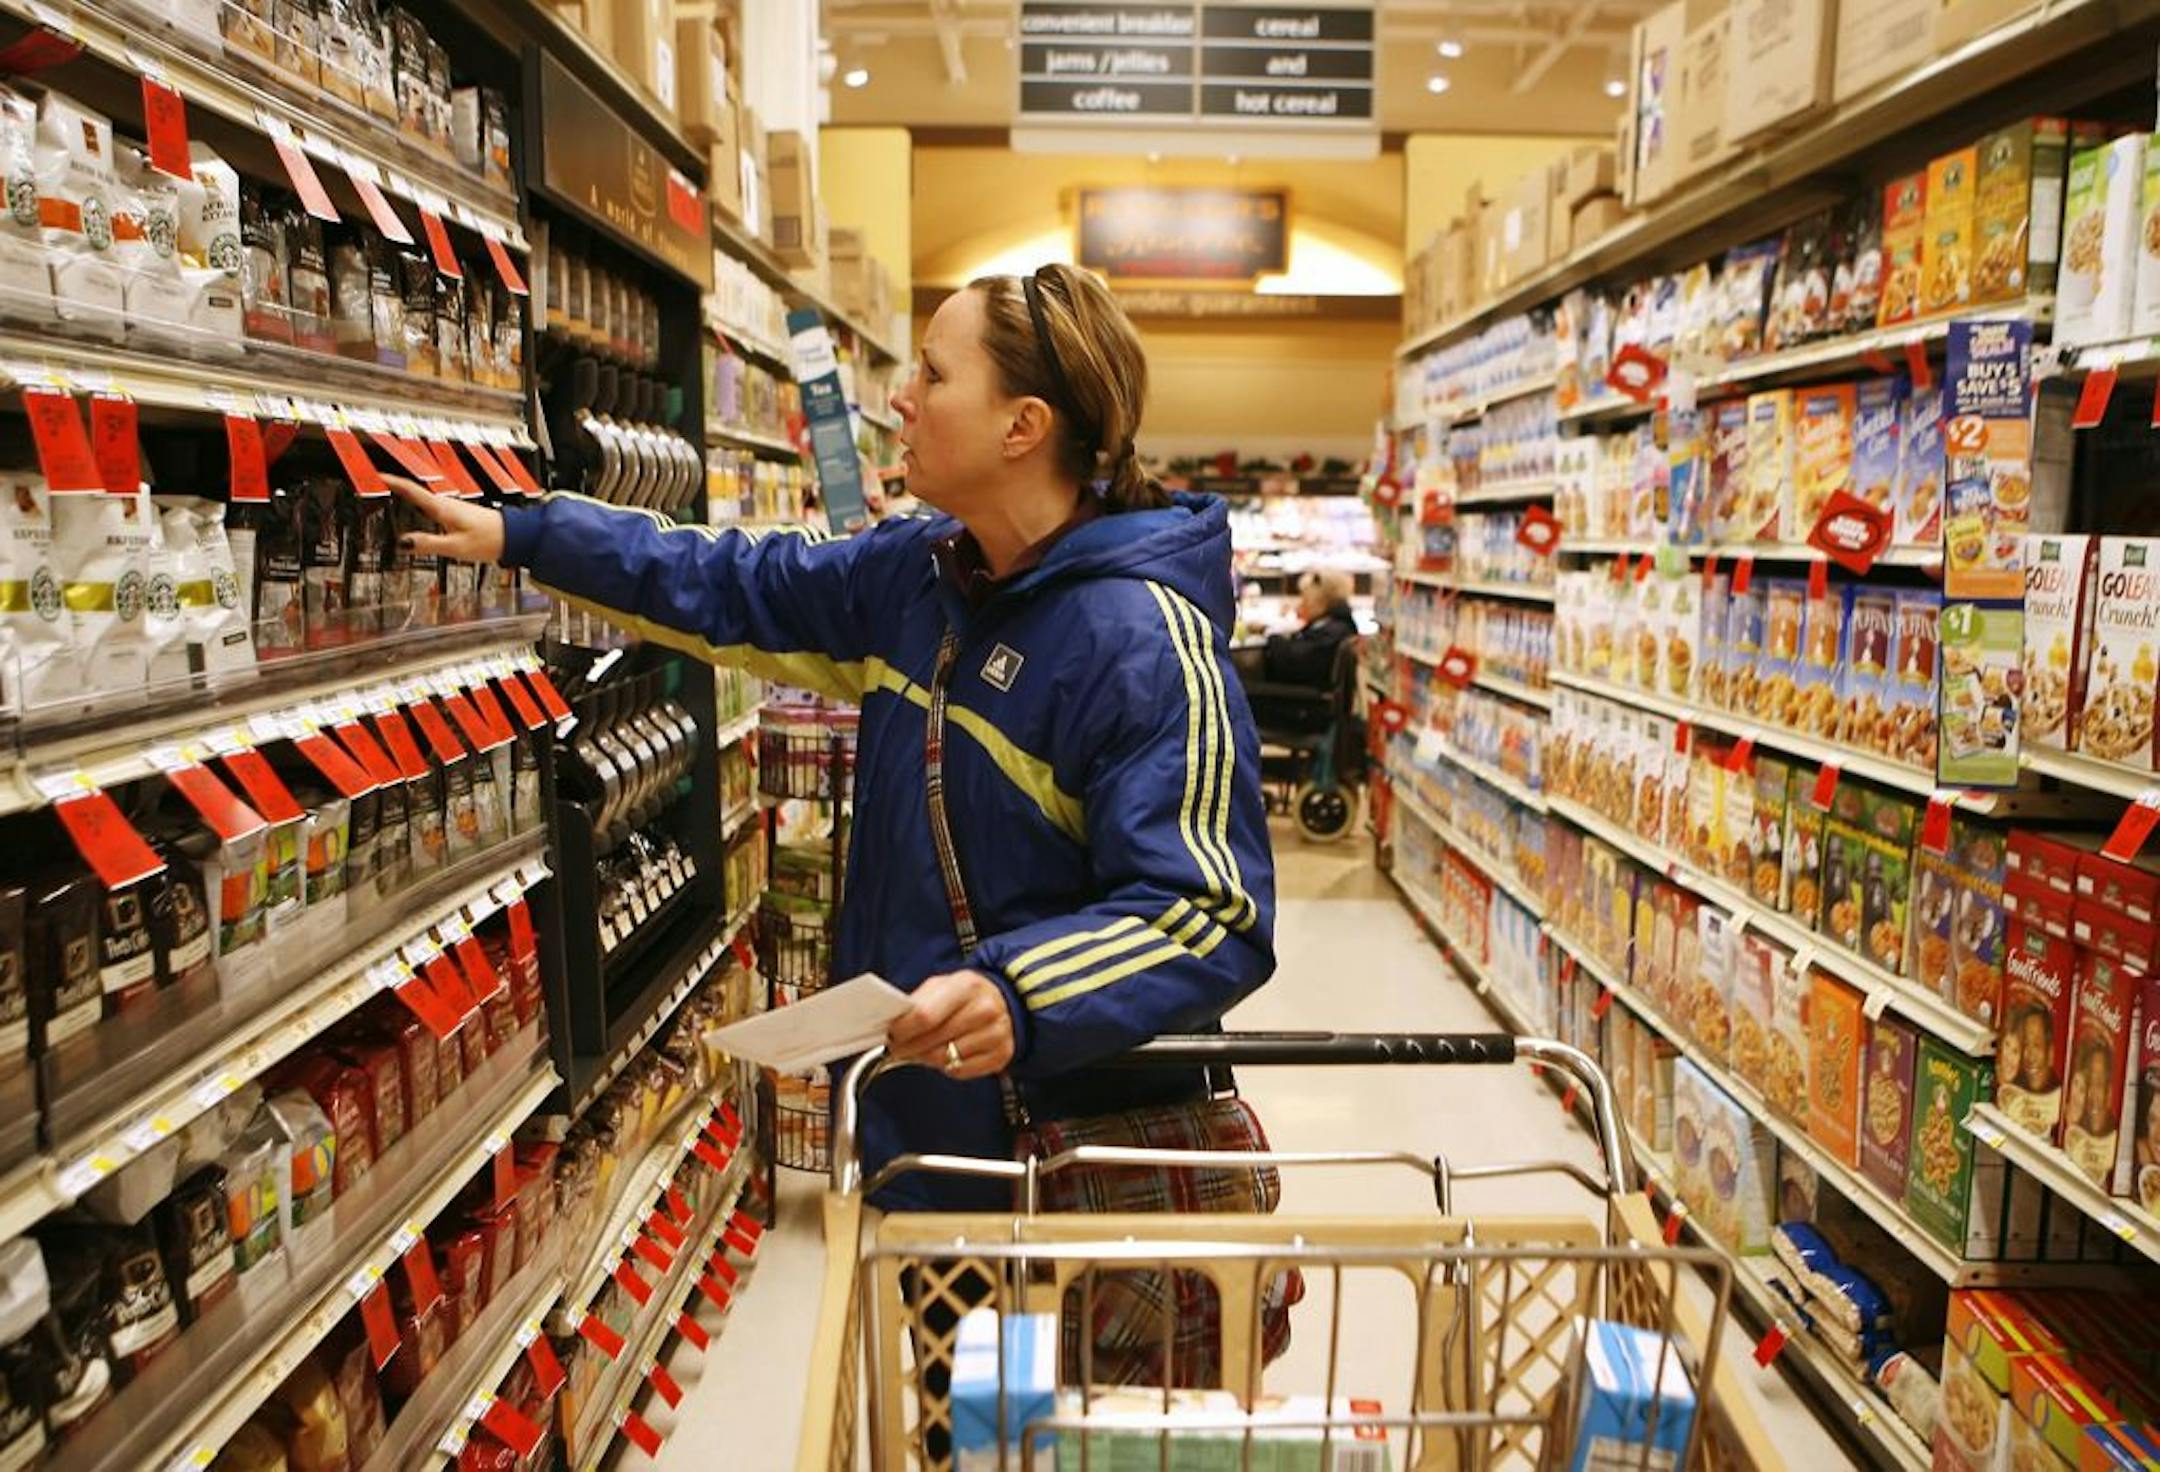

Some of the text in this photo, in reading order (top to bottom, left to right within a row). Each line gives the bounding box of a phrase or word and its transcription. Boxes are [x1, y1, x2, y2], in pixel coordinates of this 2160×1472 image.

[1021, 14, 1114, 33] convenient
[1254, 15, 1320, 37] cereal
[1046, 51, 1097, 74] jams
[1266, 54, 1308, 75] and
[1073, 89, 1141, 110] coffee
[1235, 90, 1337, 114] hot cereal
[1967, 362, 2004, 379] BUY
[1956, 378, 1999, 396] SAVE
[1948, 415, 1984, 448] $2
[1948, 603, 1974, 635] $1
[2100, 600, 2160, 628] Crunch!
